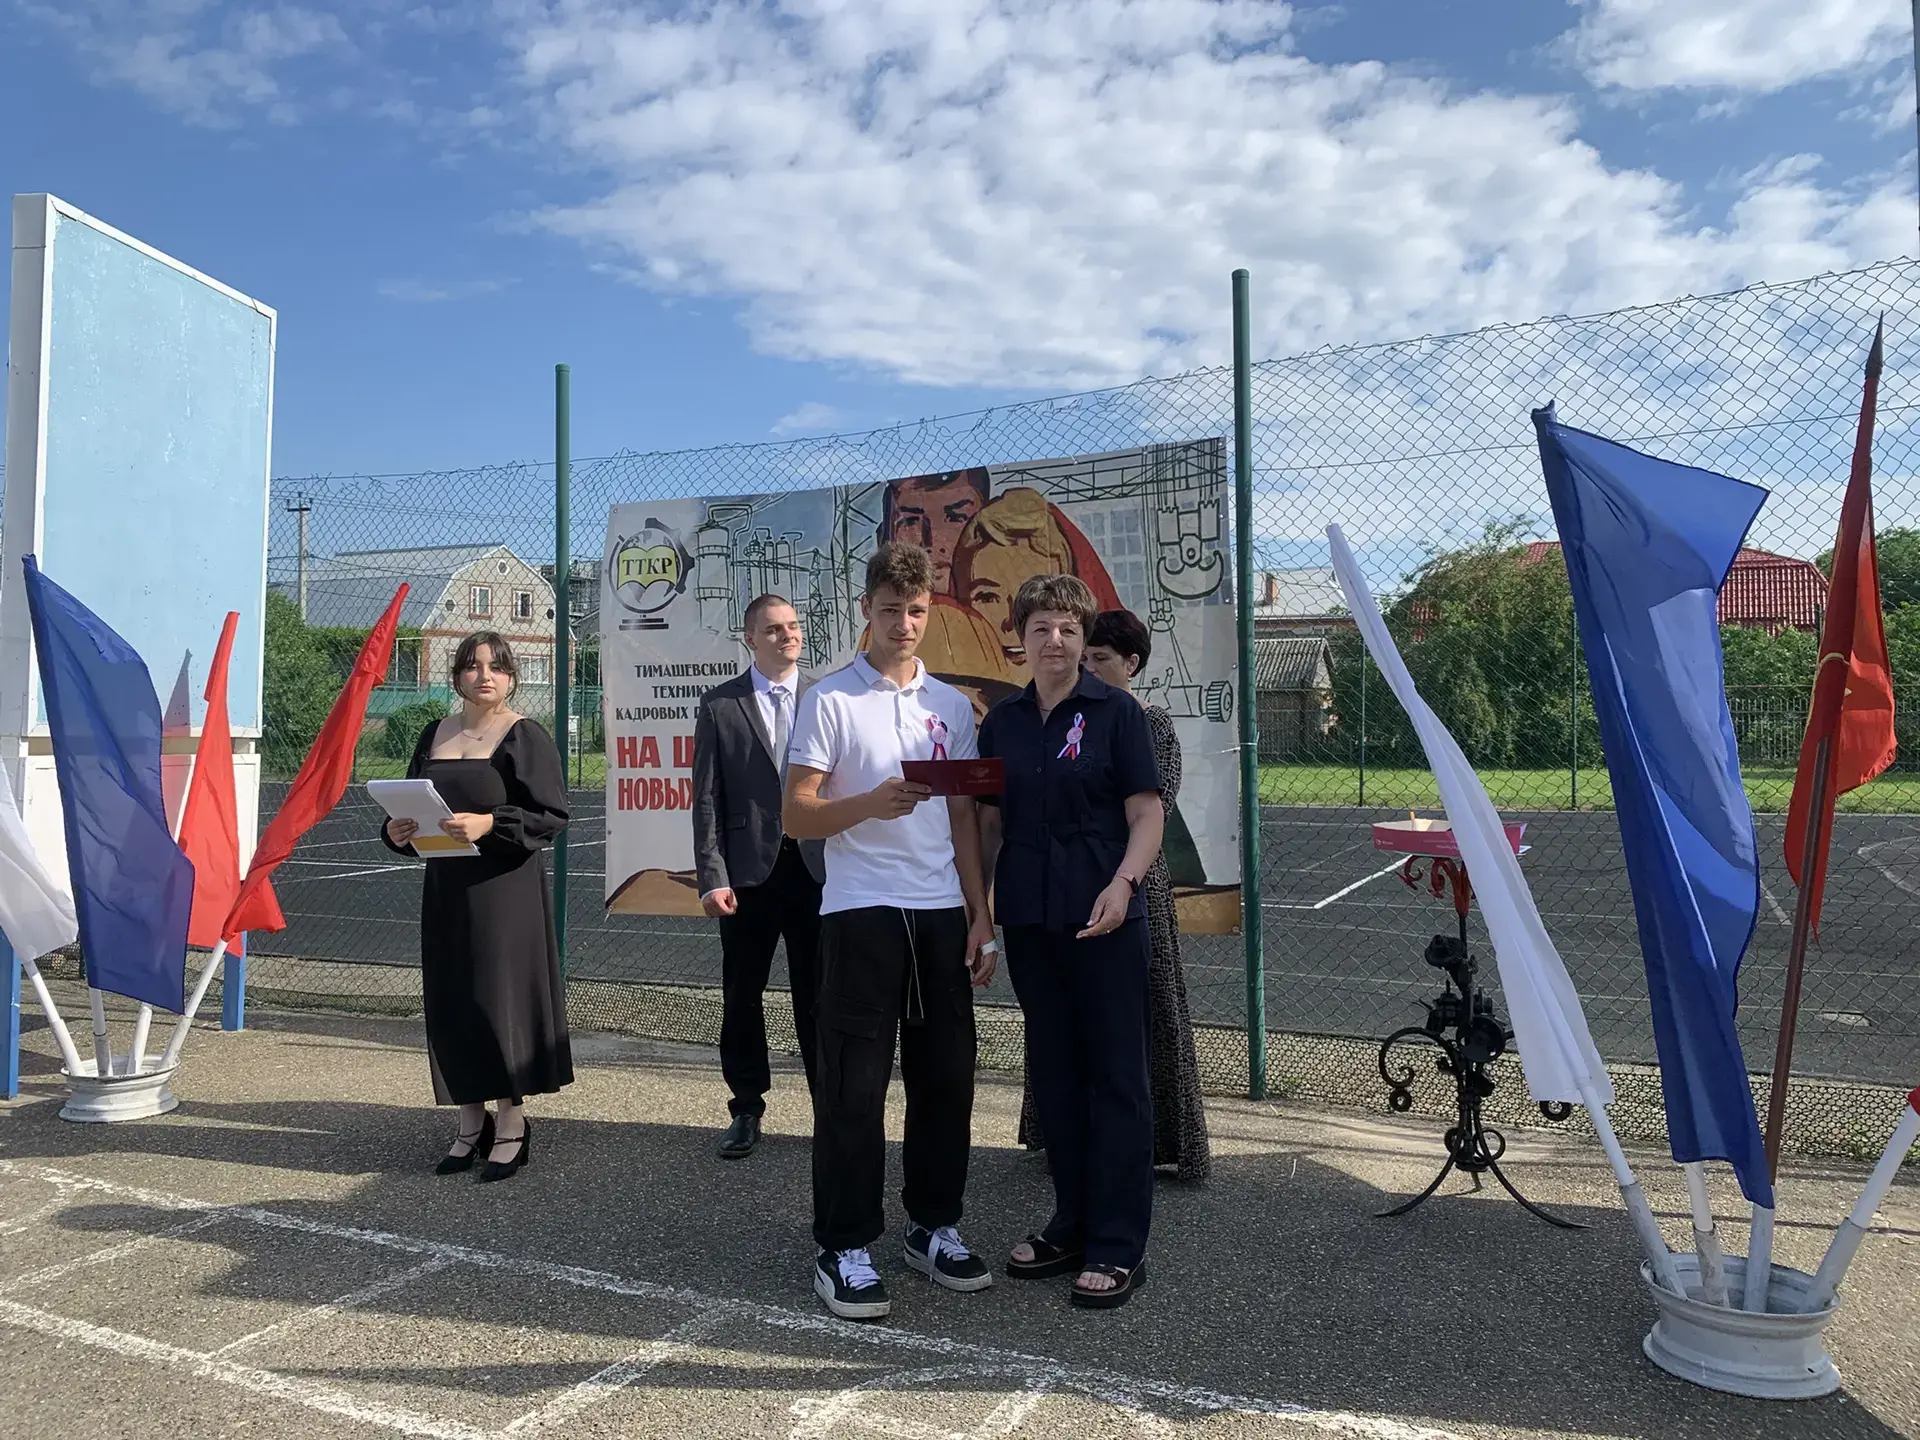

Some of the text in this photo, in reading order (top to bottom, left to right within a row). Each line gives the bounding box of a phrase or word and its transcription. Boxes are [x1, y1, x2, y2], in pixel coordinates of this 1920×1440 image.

[622, 557, 673, 576] ТТКР
[634, 660, 738, 678] ТИМАШЕВСКИЙ
[651, 684, 716, 699] ТЕХНИК
[616, 706, 689, 722] КАДРОВЫХ
[616, 736, 661, 768] НА
